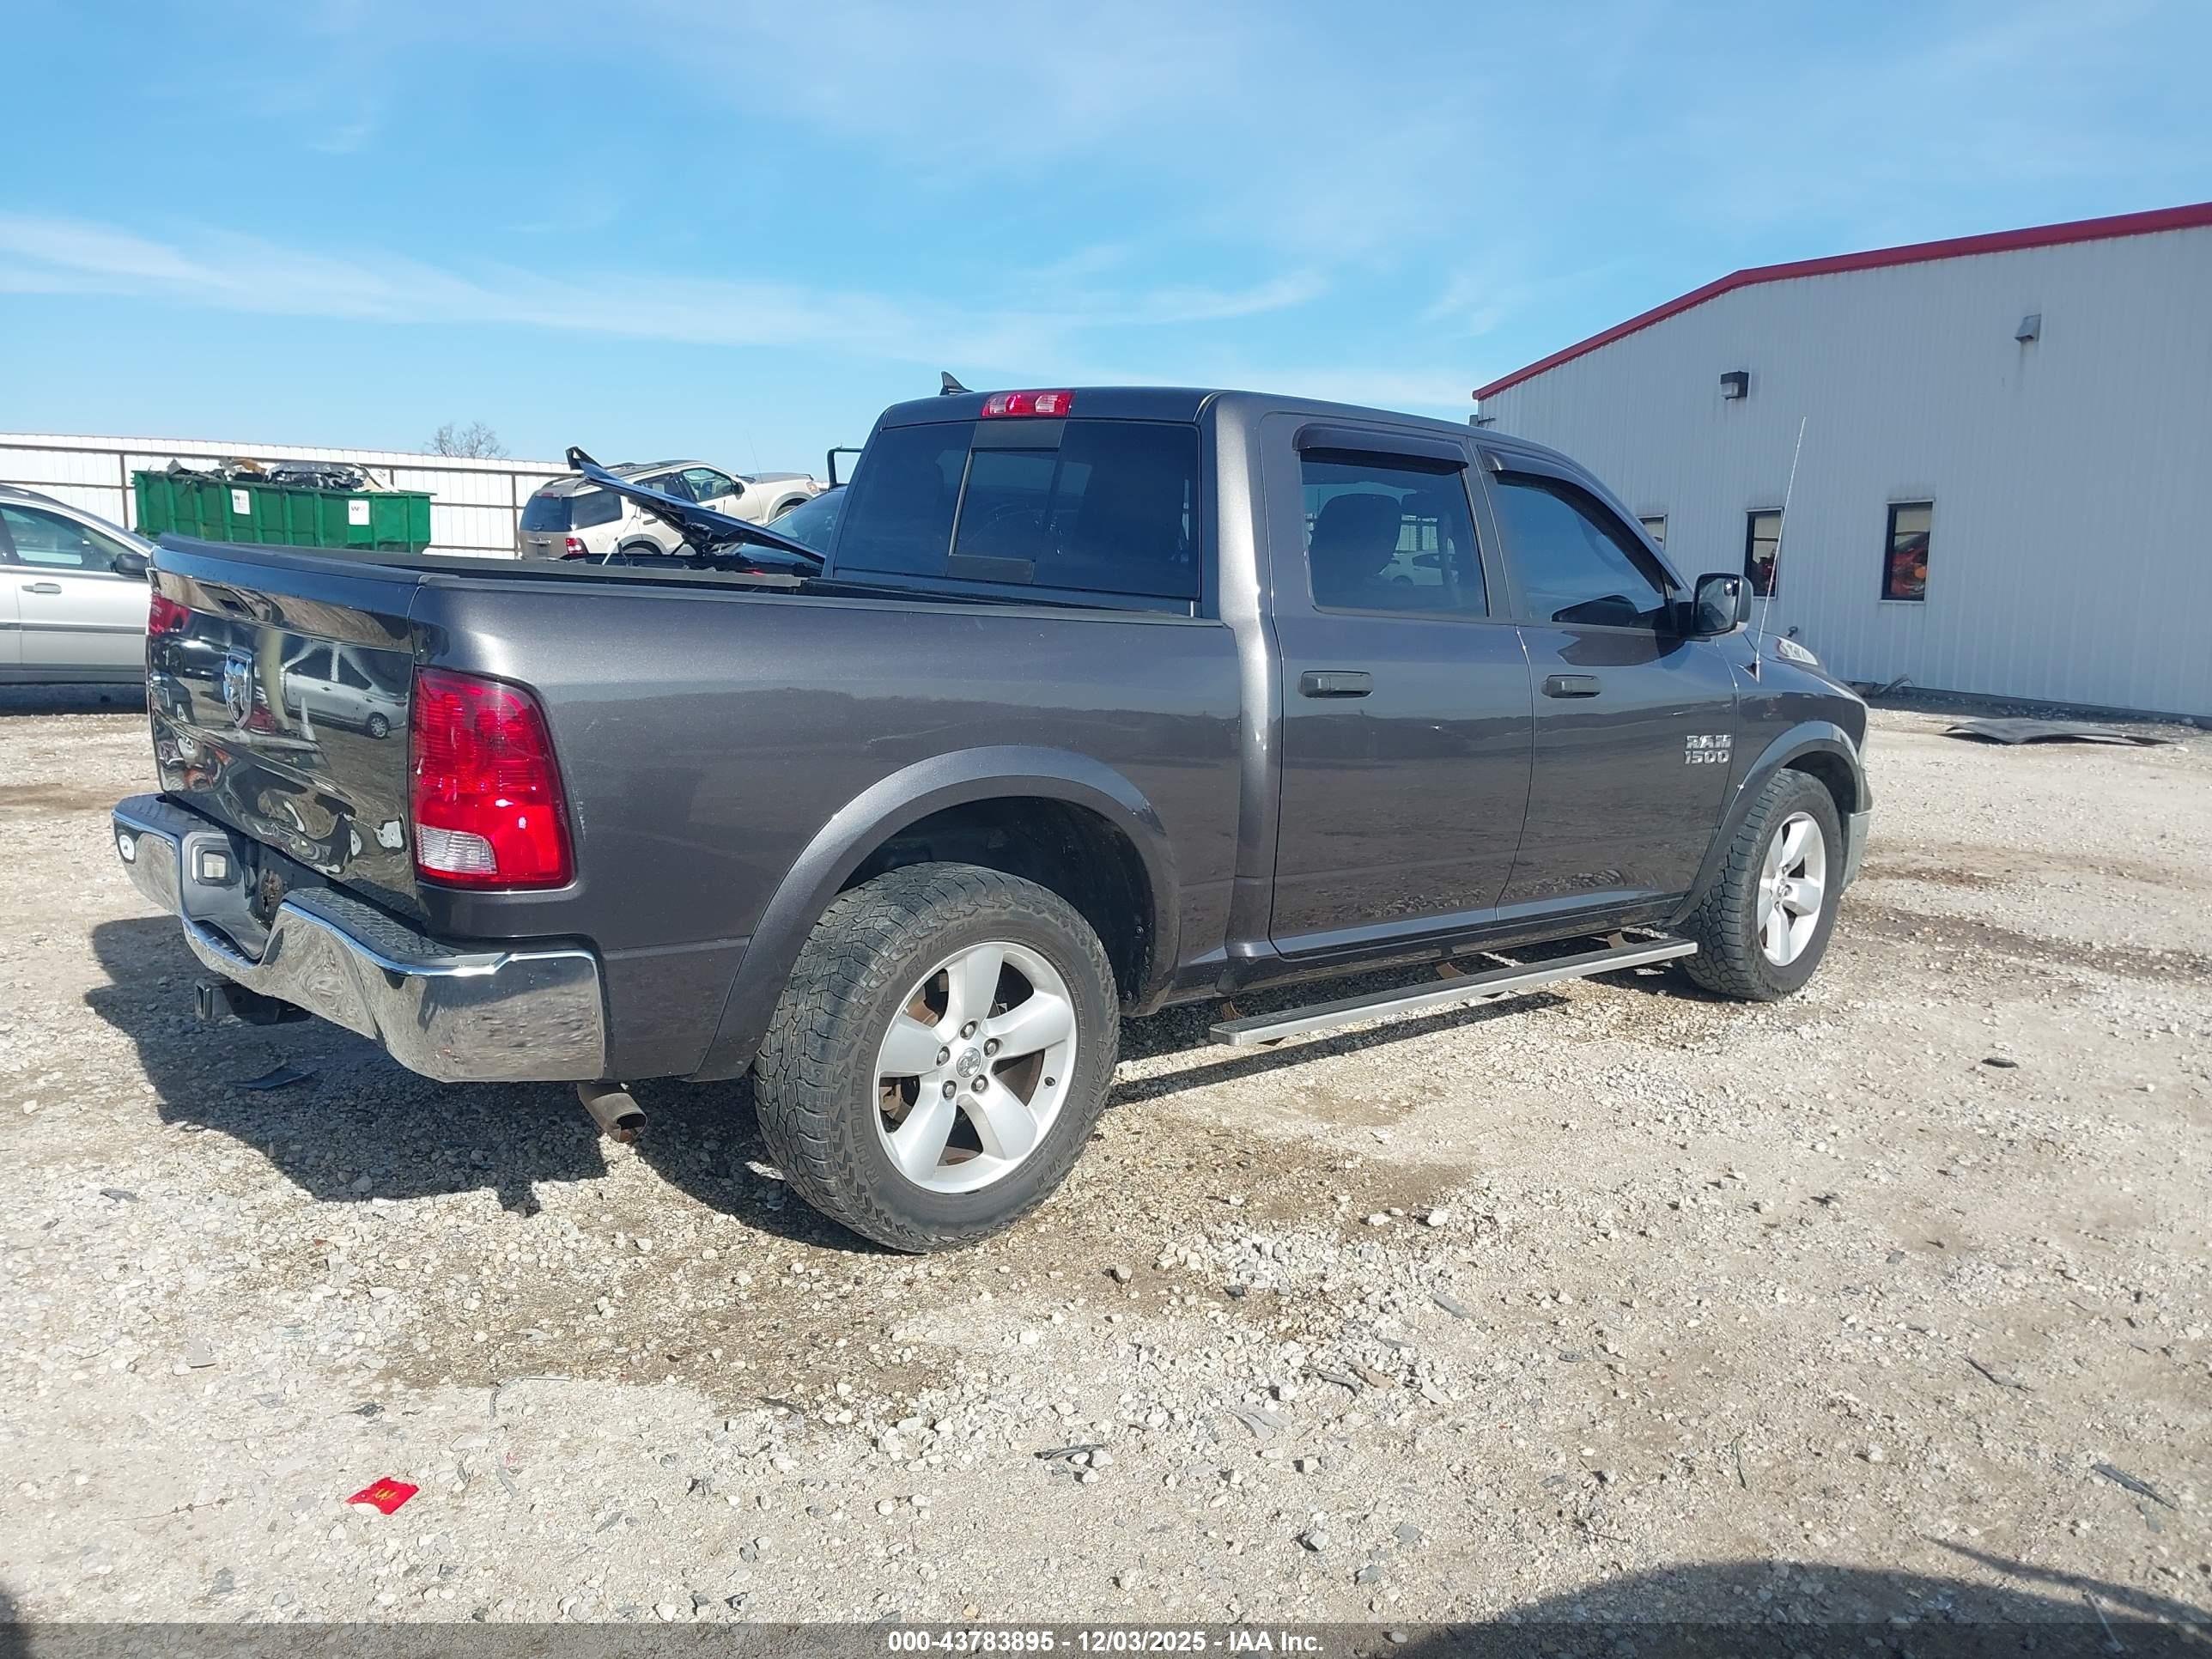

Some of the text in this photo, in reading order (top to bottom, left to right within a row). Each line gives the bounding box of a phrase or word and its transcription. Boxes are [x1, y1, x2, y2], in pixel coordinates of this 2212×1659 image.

[1685, 734, 1732, 750] RAM
[1684, 750, 1729, 764] 1500
[851, 991, 894, 1188] RUBITREK
